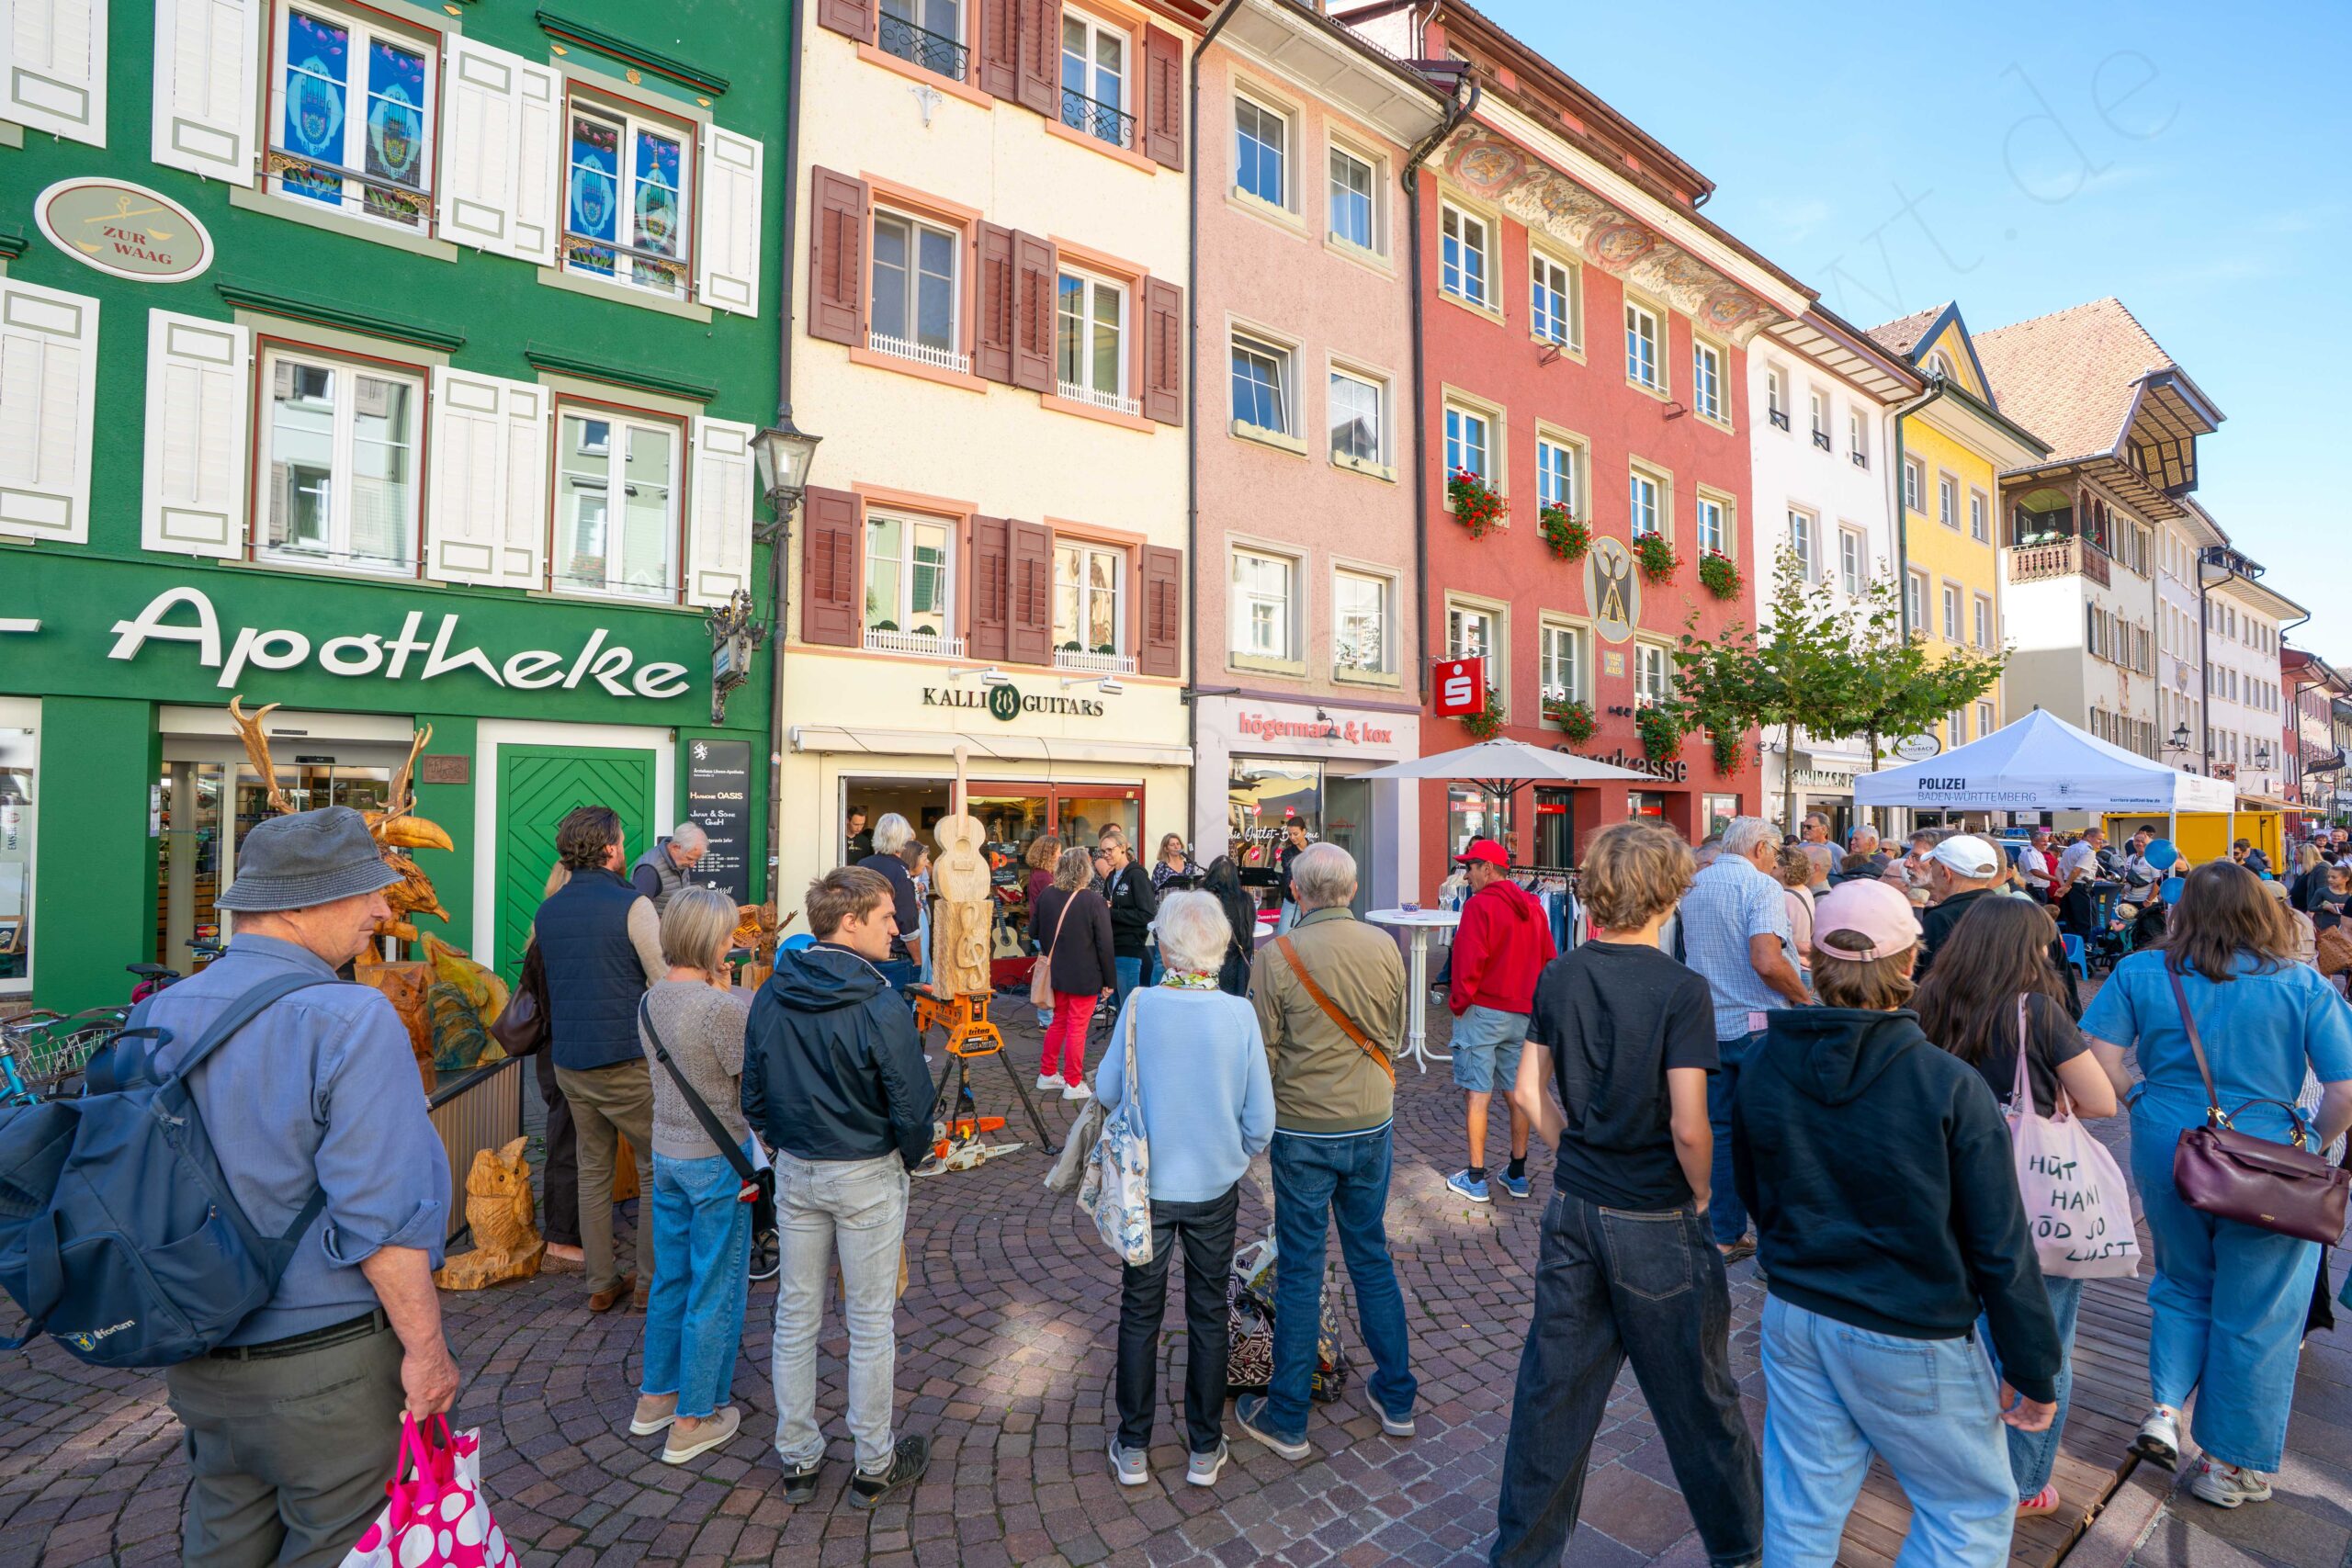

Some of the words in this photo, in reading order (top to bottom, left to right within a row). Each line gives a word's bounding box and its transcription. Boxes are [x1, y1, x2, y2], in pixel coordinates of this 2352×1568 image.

[103, 225, 145, 245] ZUR
[114, 242, 172, 265] WAAG
[107, 586, 690, 698] Apotheke
[922, 687, 988, 708] KALLI
[1022, 694, 1103, 717] GUITARS
[1238, 712, 1340, 741] högermann
[1344, 720, 1360, 745] &
[1363, 722, 1393, 744] kox
[1918, 777, 1966, 790] POLIZEI
[717, 792, 743, 800] OASIS
[1917, 790, 2037, 802] BADEN-WÜRTTEMBERG
[709, 809, 717, 818] &
[2086, 1216, 2105, 1240] SO
[2065, 1241, 2134, 1262] LUST
